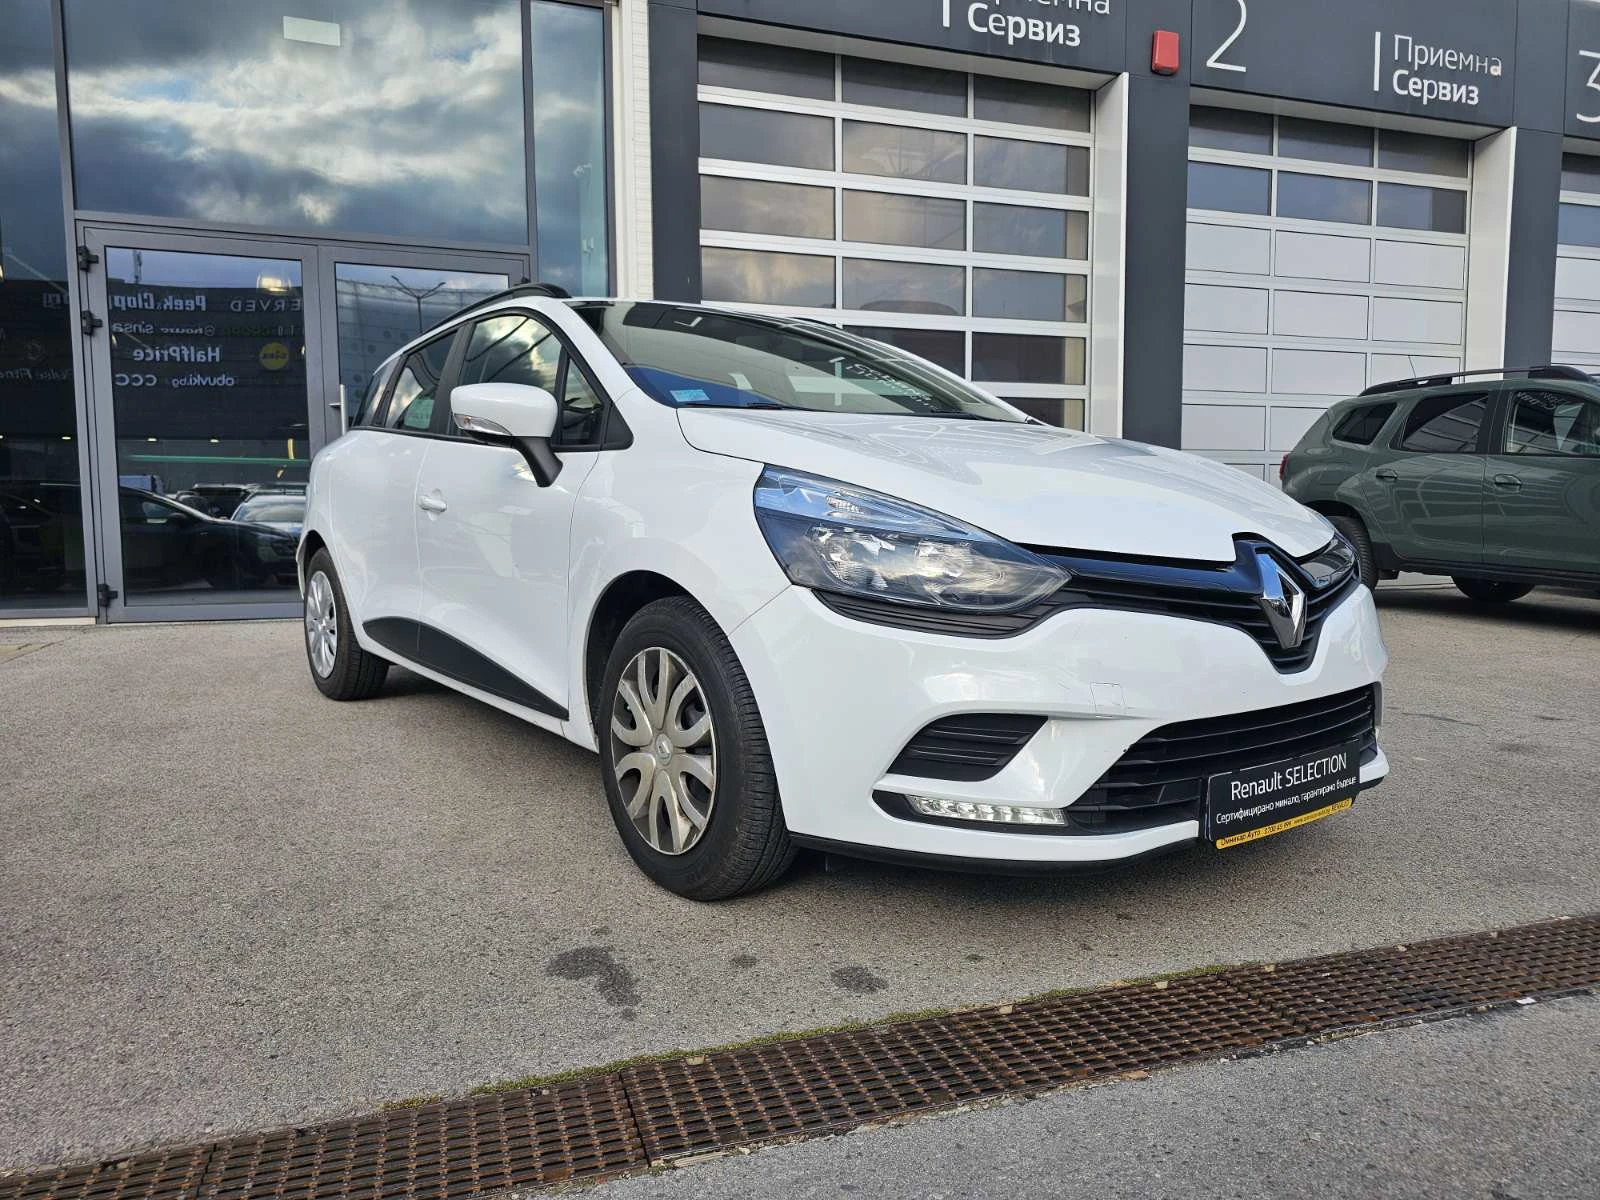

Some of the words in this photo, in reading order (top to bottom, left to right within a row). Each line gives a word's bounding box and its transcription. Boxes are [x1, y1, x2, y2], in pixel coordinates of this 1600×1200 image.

[967, 2, 1081, 47] Сервиз
[1206, 0, 1247, 72] 2
[1394, 34, 1502, 76] Приемна
[1393, 69, 1479, 105] Сервиз
[1576, 49, 1600, 123] 3
[1231, 771, 1283, 800] Renault
[1285, 752, 1347, 787] SELECTION
[1216, 802, 1275, 825] Сертифицирано
